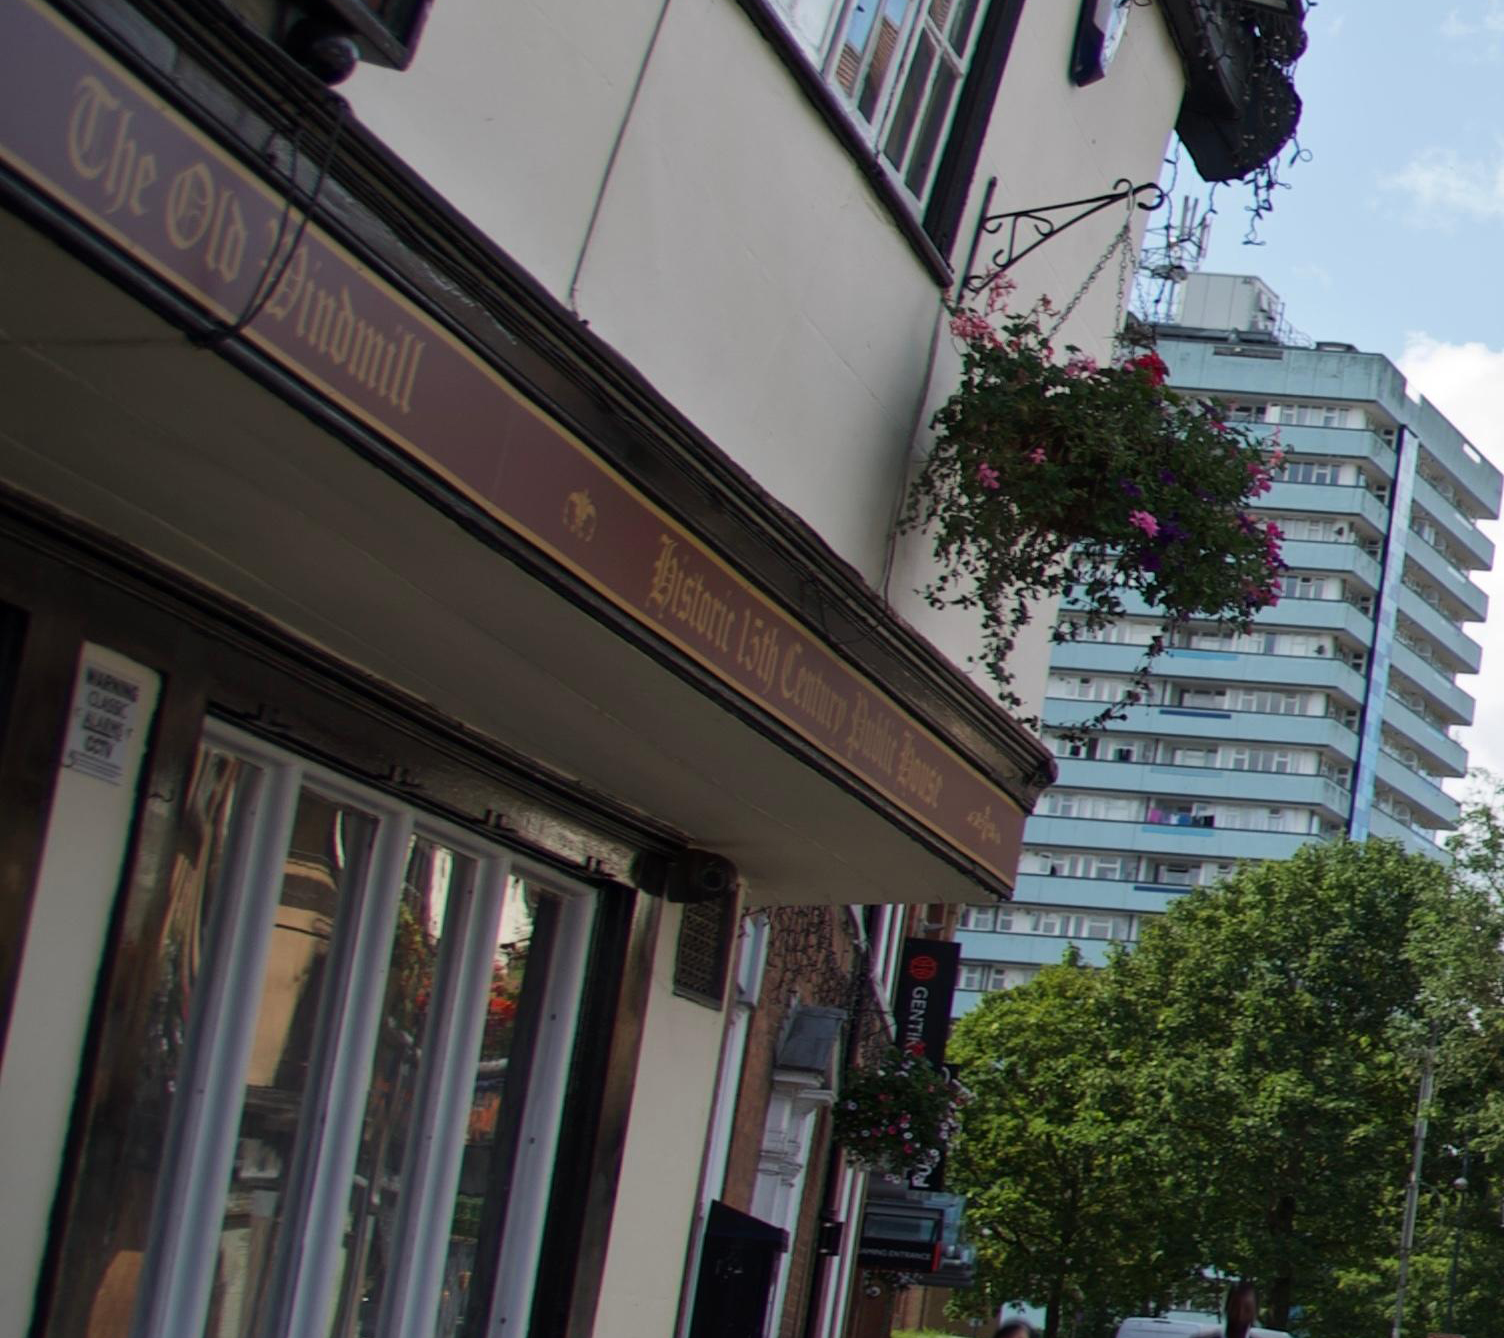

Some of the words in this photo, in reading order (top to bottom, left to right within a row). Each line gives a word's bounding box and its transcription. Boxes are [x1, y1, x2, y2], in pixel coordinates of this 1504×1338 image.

[69, 74, 158, 216] The
[167, 161, 249, 283] Old
[648, 534, 736, 653] Historic
